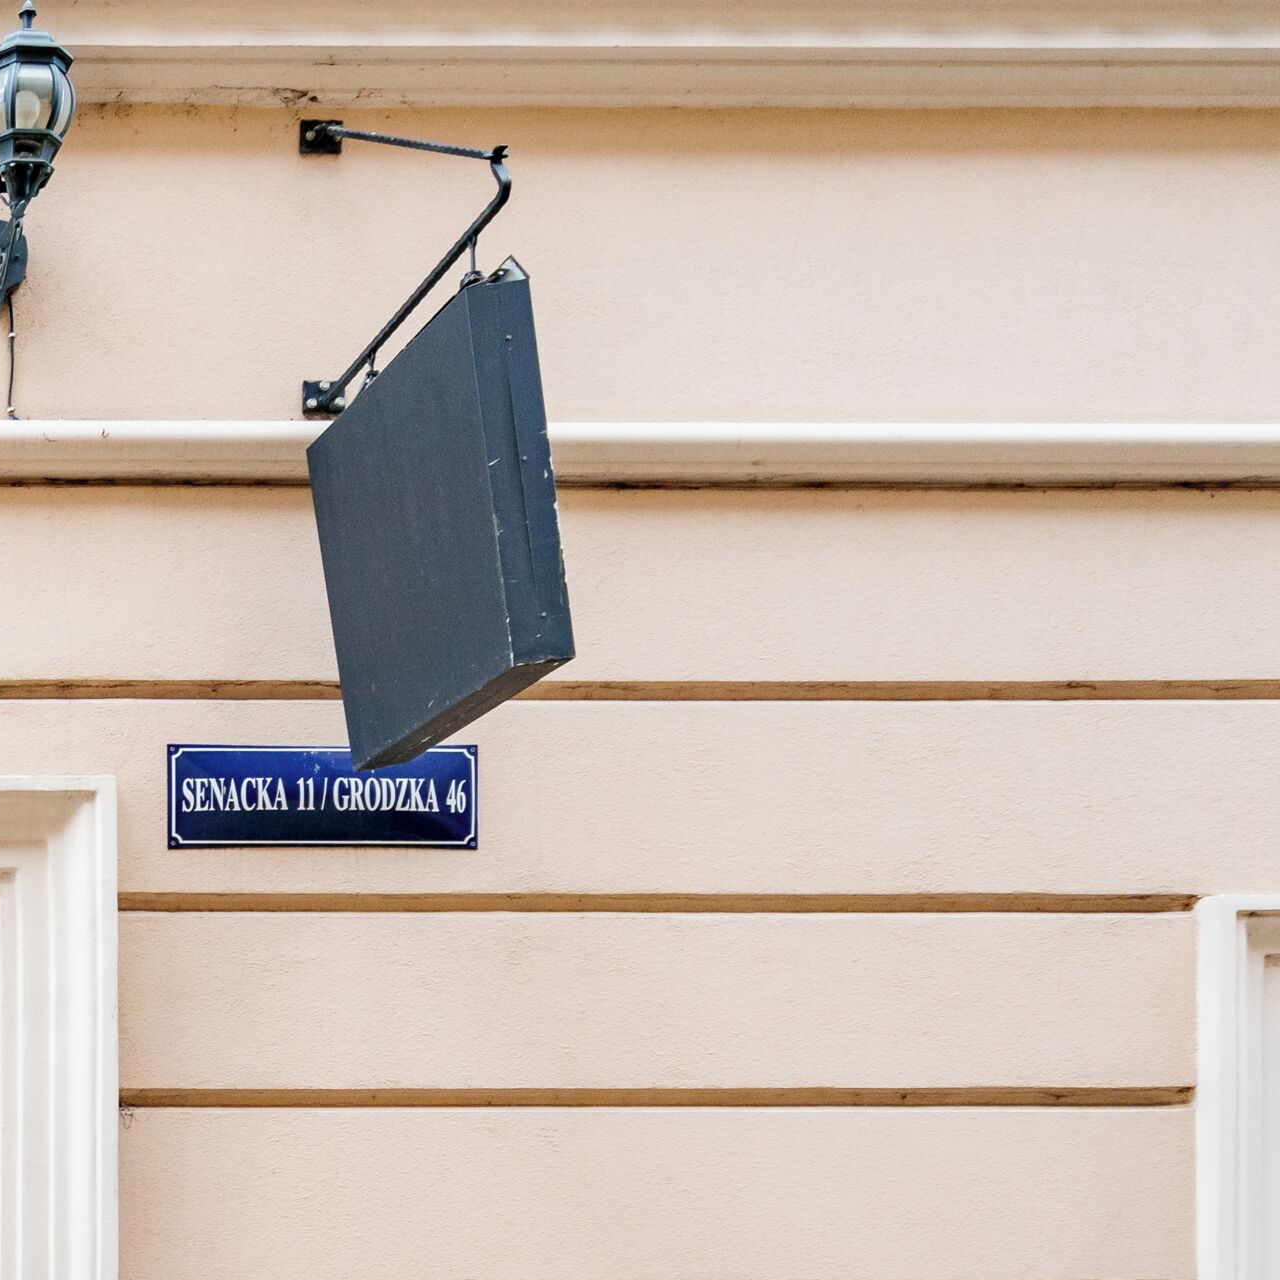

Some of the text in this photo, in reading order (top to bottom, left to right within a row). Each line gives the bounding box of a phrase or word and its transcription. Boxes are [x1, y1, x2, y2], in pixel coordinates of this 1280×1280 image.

[182, 777, 288, 812] SENACKA
[296, 777, 315, 811] 11
[333, 777, 439, 813] GRODZKA
[446, 779, 467, 813] 46
